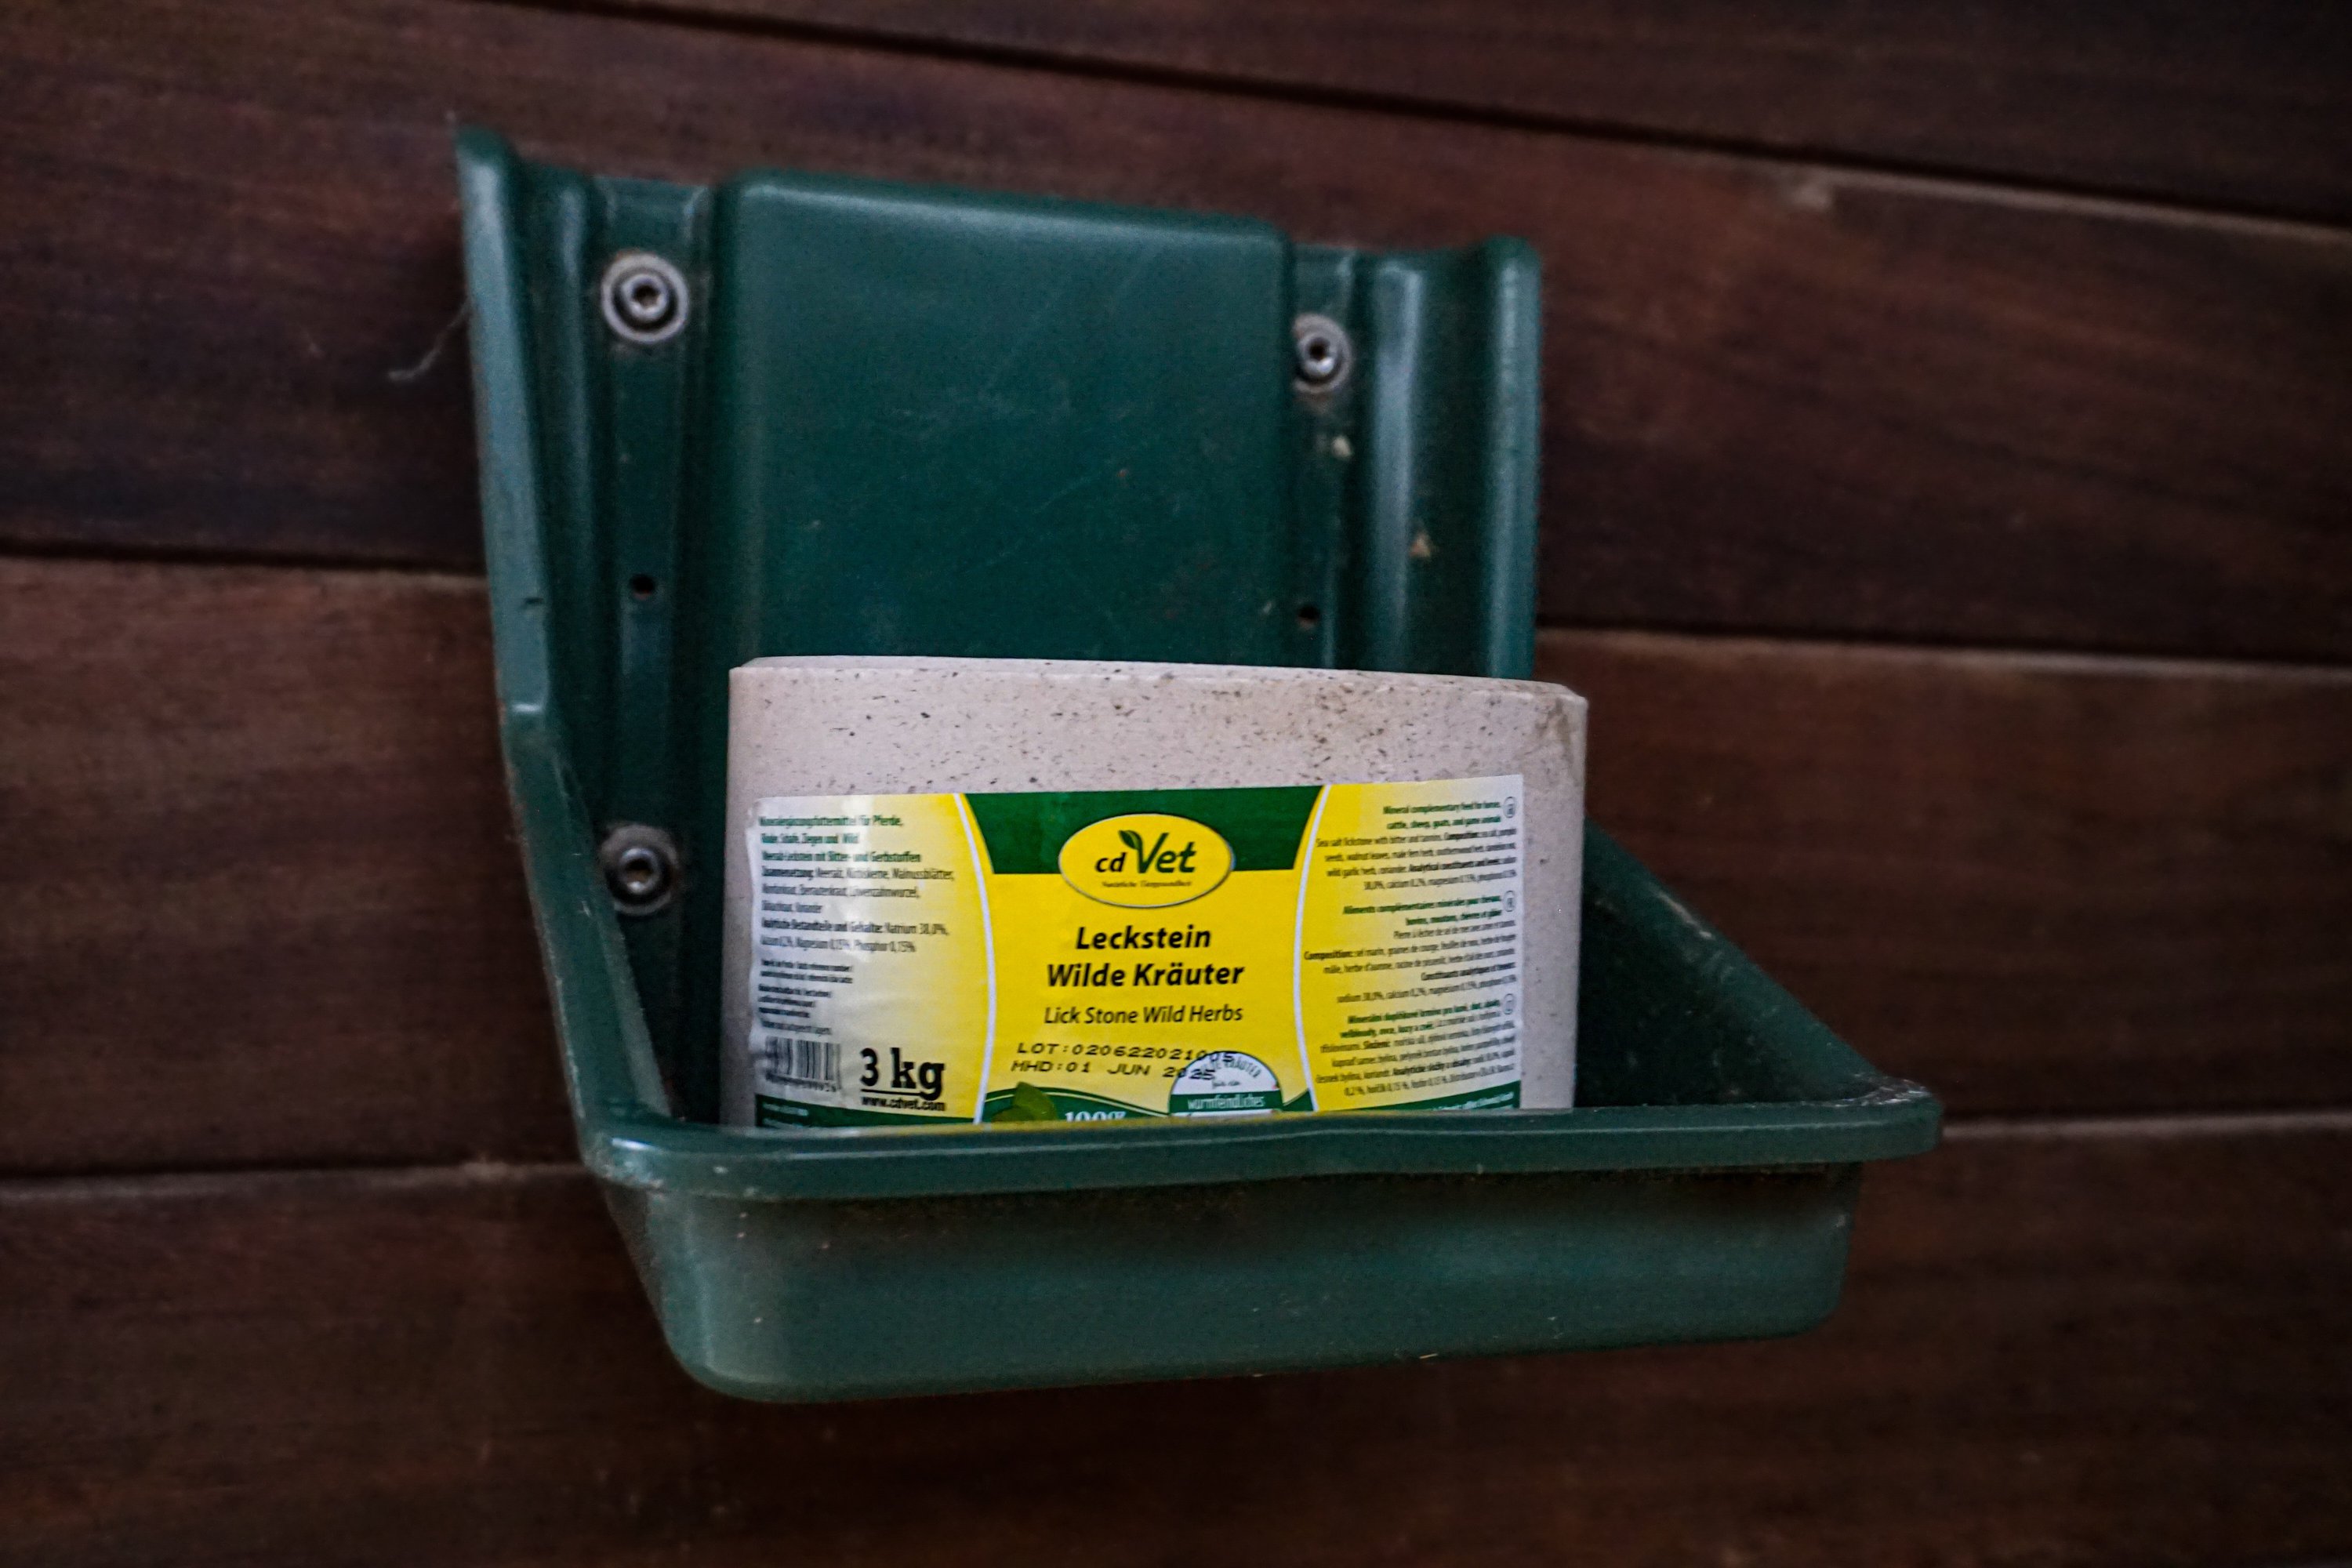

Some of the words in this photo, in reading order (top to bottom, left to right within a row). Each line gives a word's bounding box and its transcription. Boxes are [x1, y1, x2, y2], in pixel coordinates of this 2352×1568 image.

[1075, 924, 1211, 949] Leckstein
[1047, 963, 1126, 987] Wilde
[1132, 961, 1245, 986] Kräuter
[1044, 1006, 1080, 1024] Lick
[1083, 1007, 1138, 1024] Stone
[1142, 1004, 1185, 1023] Wild
[1189, 1004, 1243, 1022] Herbs
[860, 1047, 879, 1087] 3
[891, 1047, 946, 1101] kg
[1106, 1062, 1151, 1076] JUN
